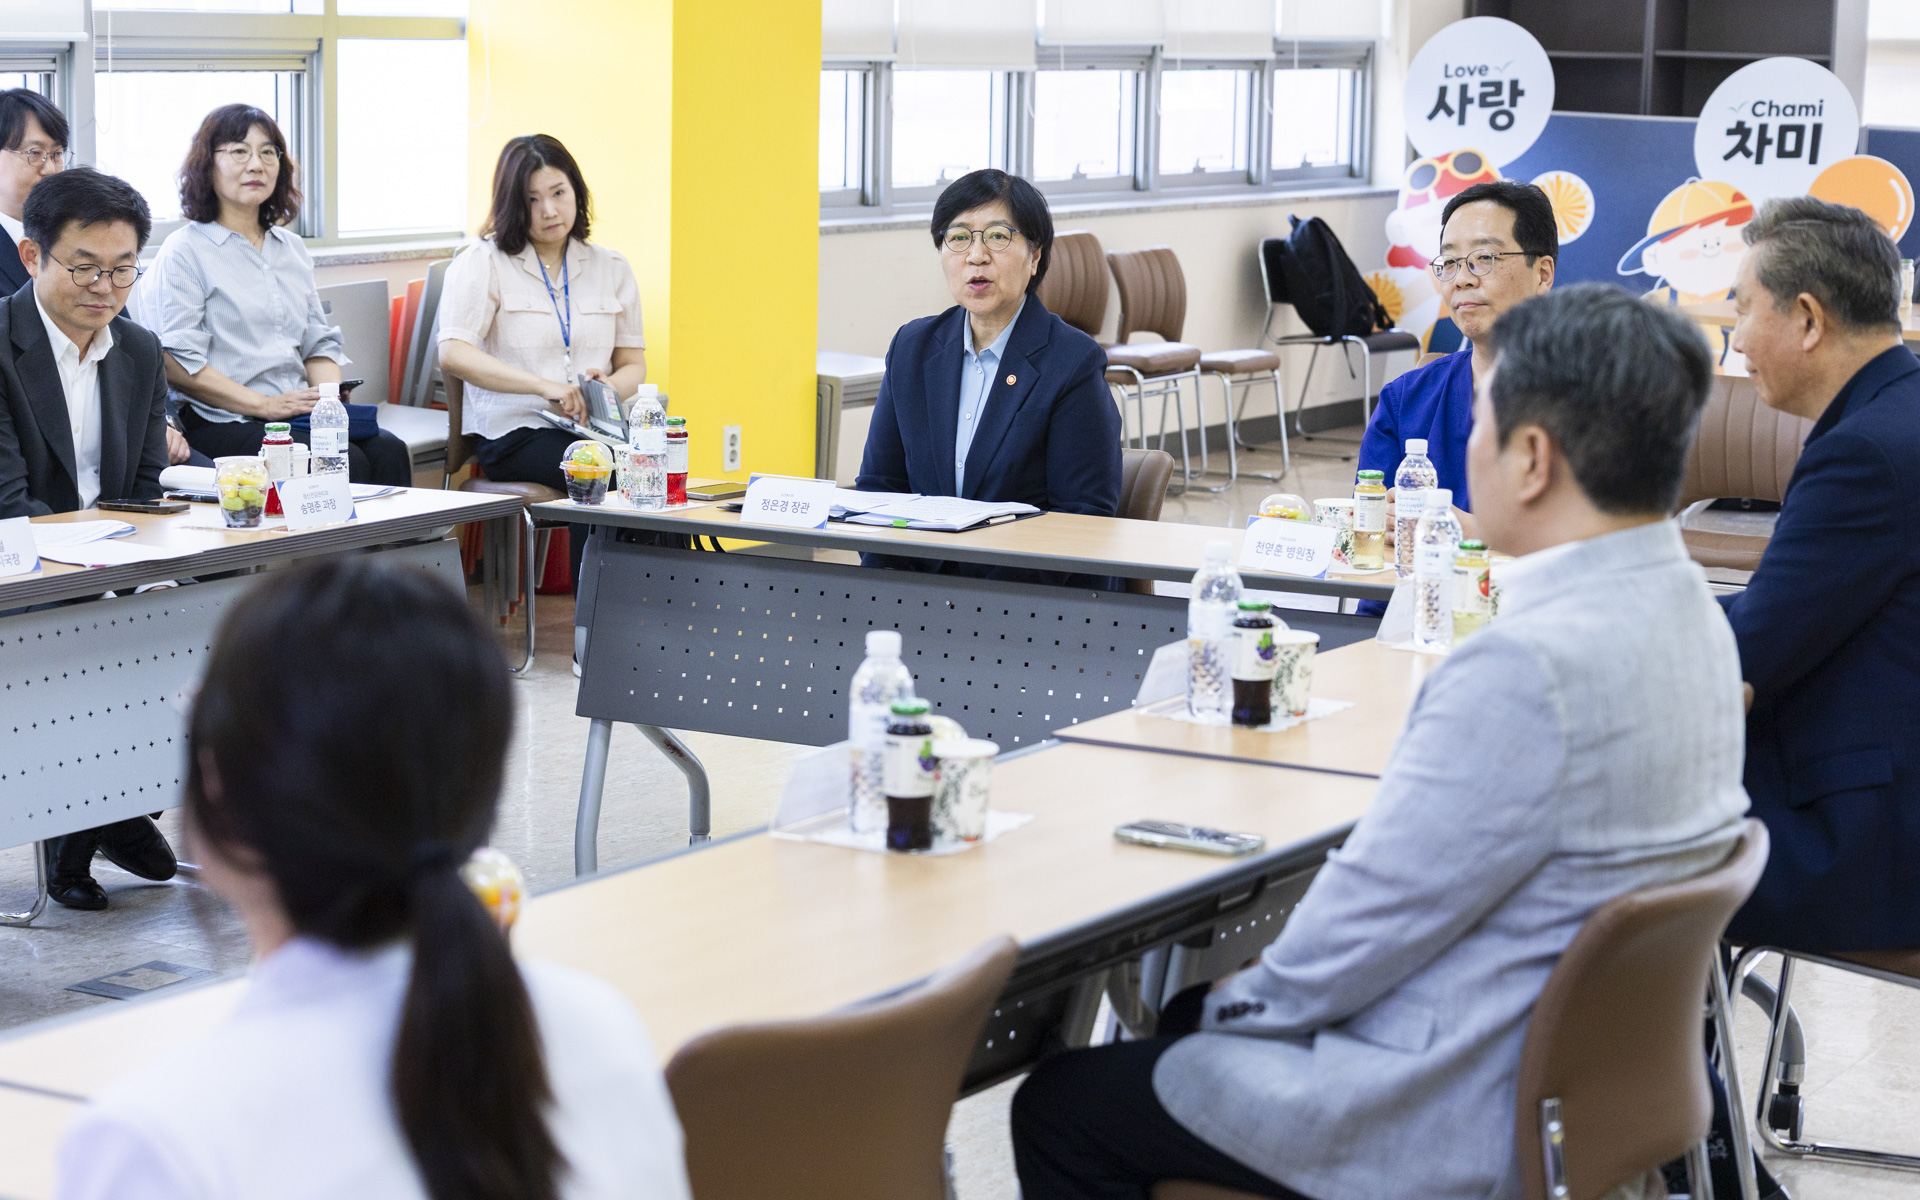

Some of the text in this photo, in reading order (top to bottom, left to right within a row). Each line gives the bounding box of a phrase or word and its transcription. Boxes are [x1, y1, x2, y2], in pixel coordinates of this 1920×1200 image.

[1444, 63, 1489, 78] Love
[1427, 79, 1525, 131] 사랑
[1751, 99, 1824, 117] Chami
[1723, 120, 1823, 165] 차미
[300, 498, 337, 515] 송명준 과장
[761, 498, 810, 514] 정은경 장관
[1286, 546, 1316, 562] 병원장
